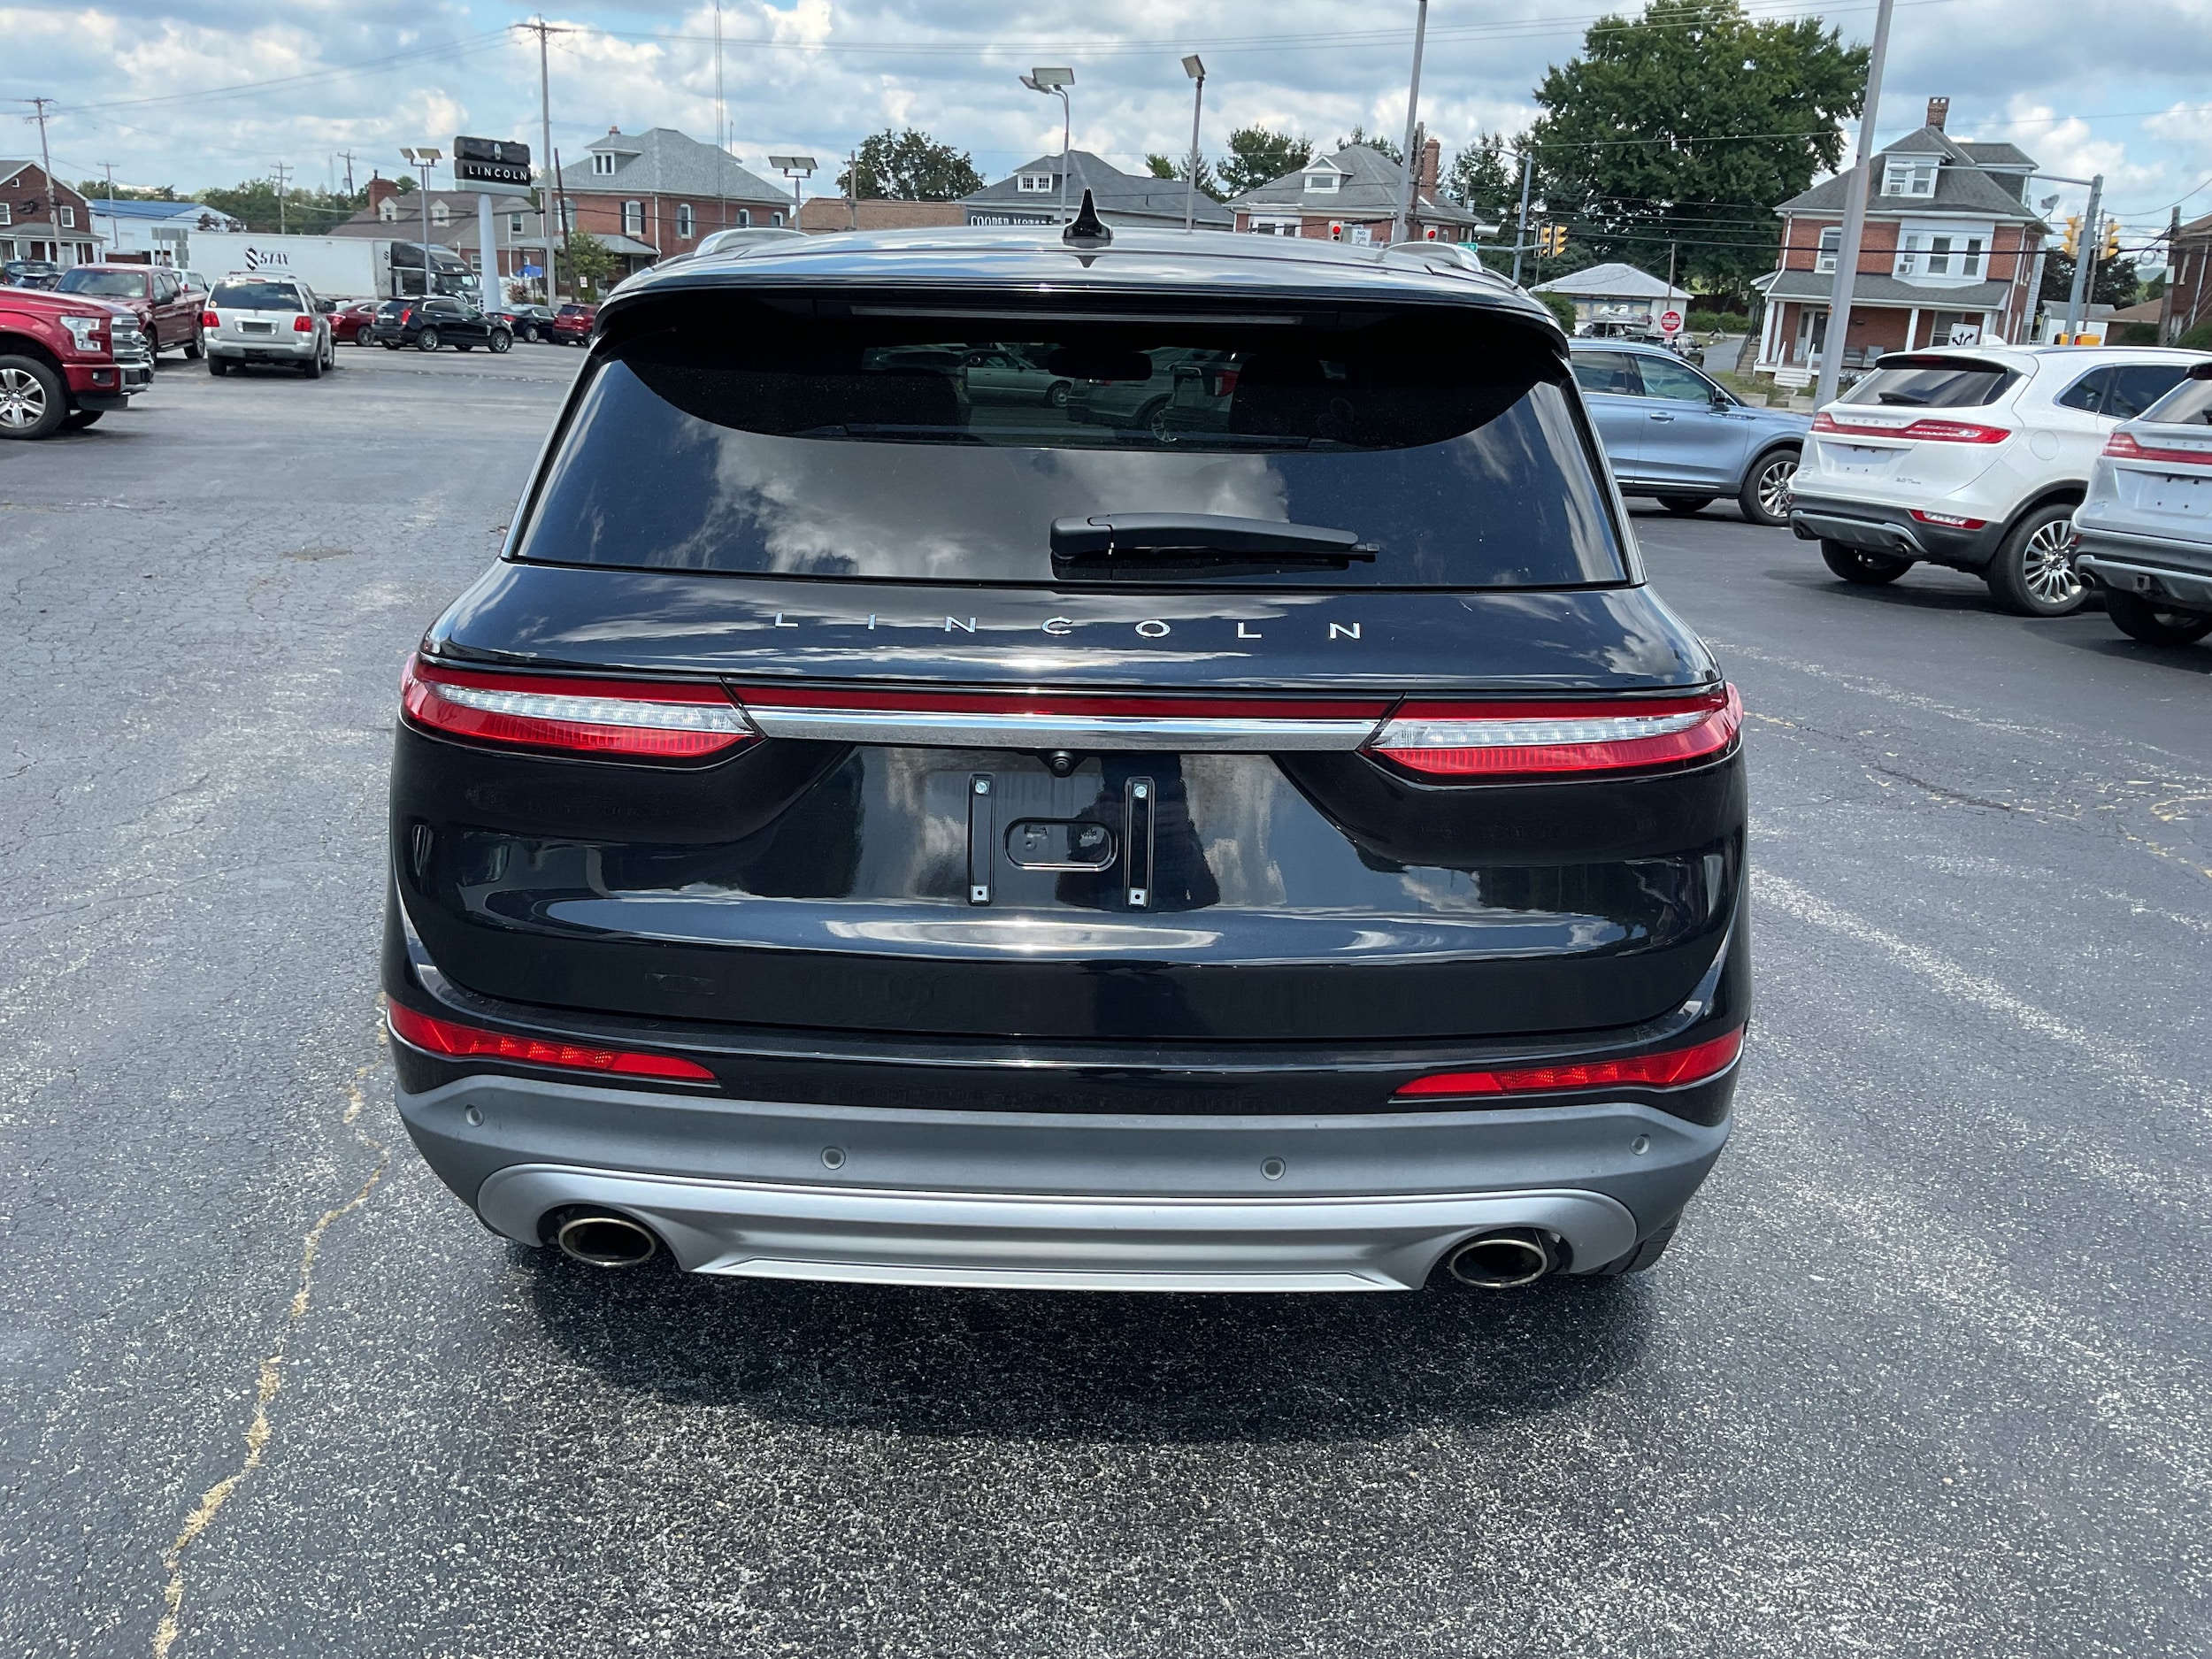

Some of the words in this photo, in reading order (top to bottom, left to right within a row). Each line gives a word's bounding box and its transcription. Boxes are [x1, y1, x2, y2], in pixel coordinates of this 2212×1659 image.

[468, 165, 527, 181] LINCOLN
[260, 252, 288, 265] STAX
[774, 611, 1361, 640] LINCOLN
